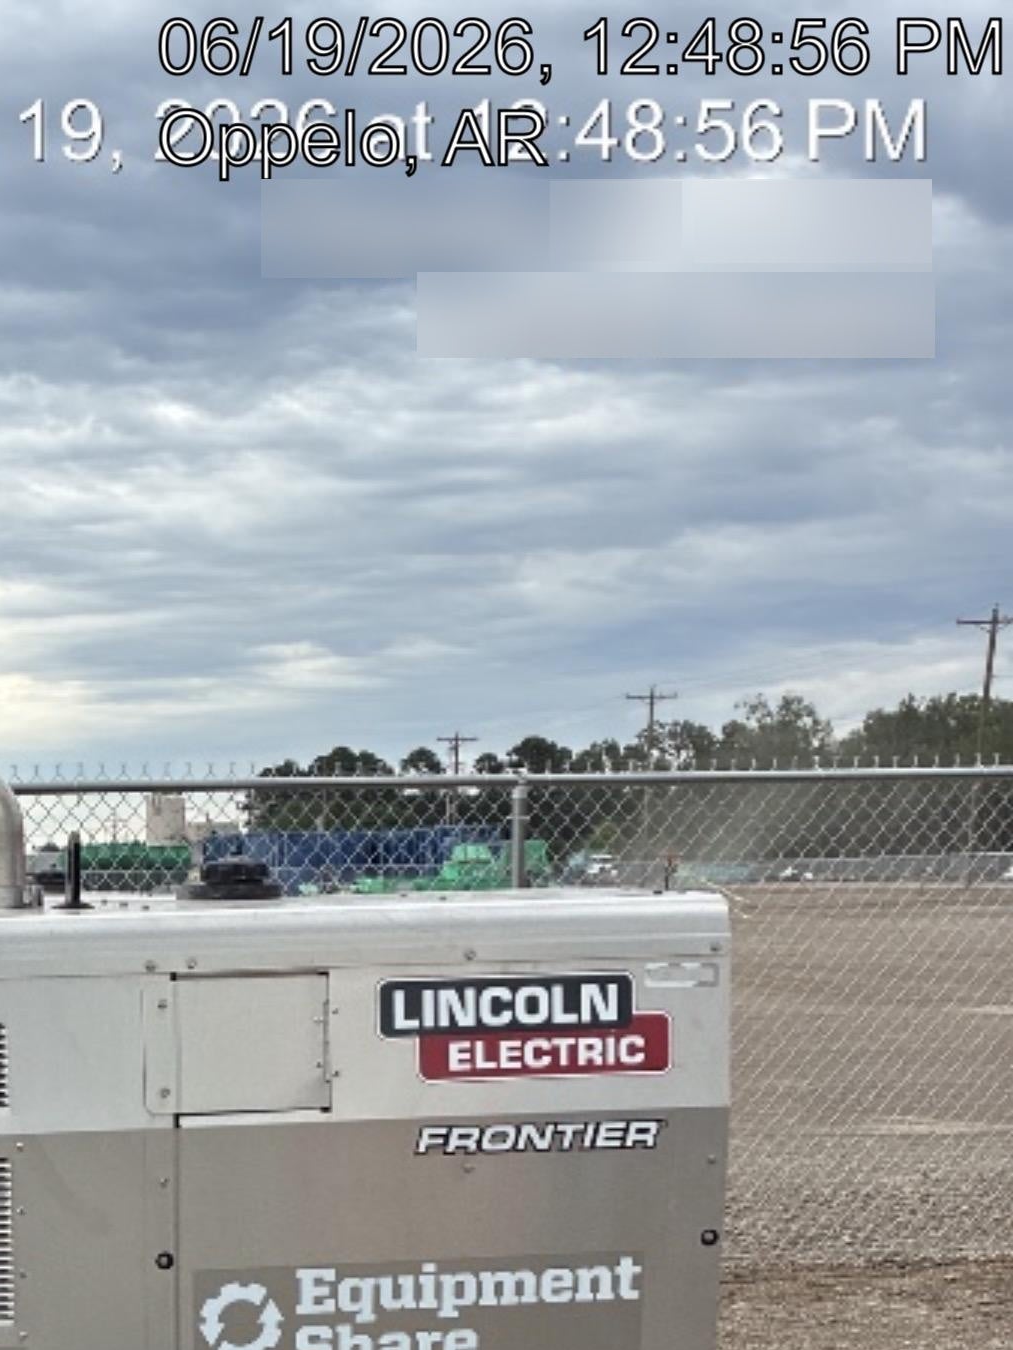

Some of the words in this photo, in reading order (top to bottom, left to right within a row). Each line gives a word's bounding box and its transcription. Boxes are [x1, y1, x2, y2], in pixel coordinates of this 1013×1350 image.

[392, 983, 618, 1030] LINCOLN
[448, 1034, 645, 1072] ELECTRIC
[414, 1120, 662, 1156] FRONTIER
[295, 1256, 642, 1323] Equipment
